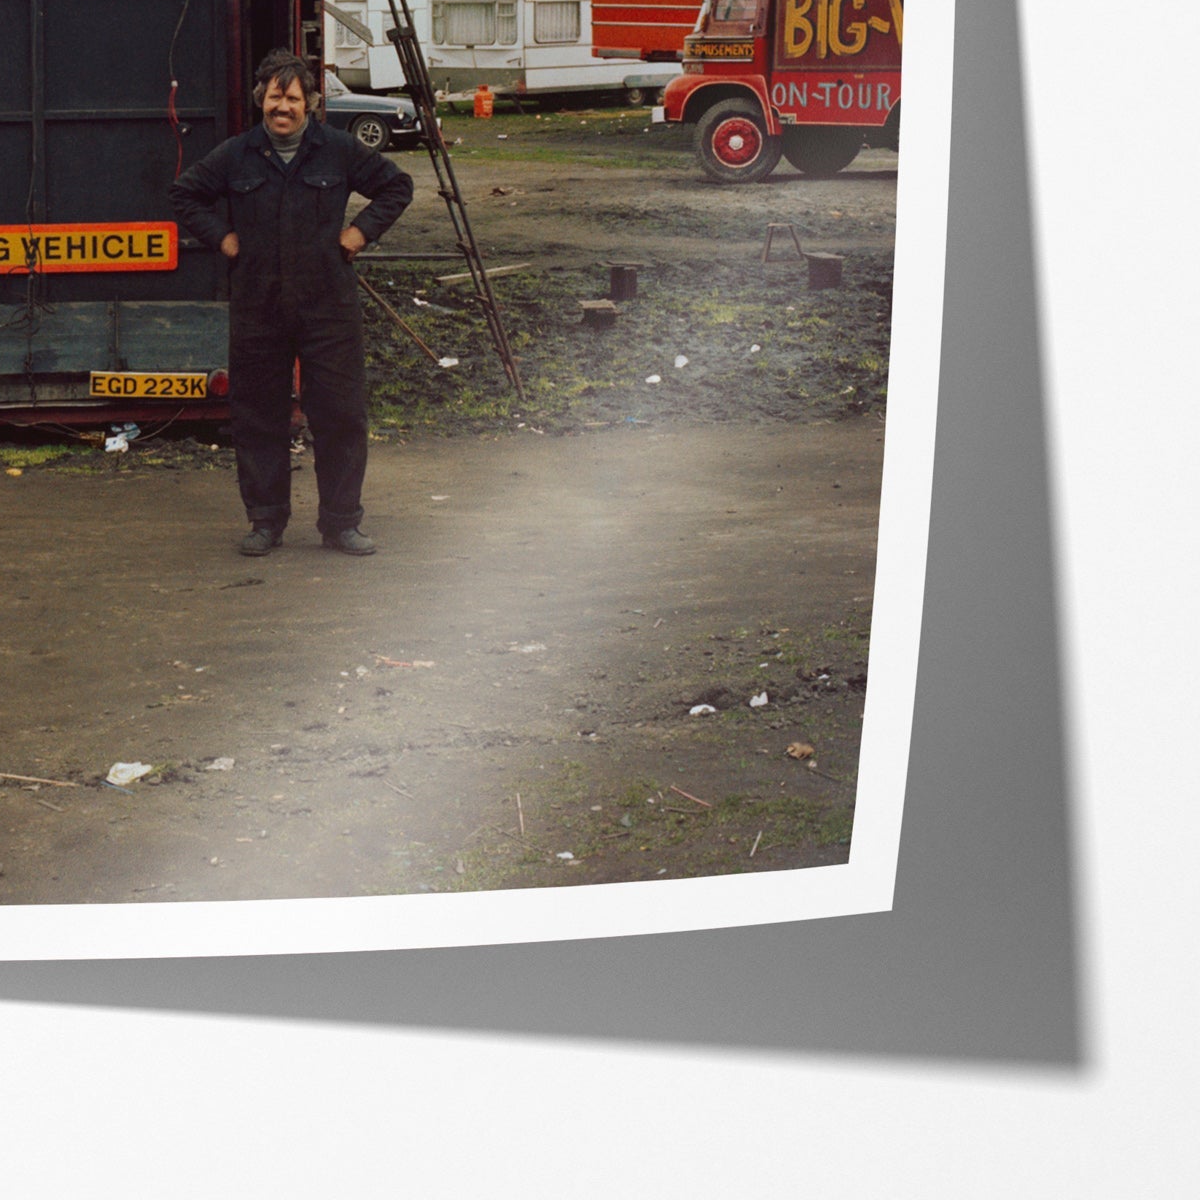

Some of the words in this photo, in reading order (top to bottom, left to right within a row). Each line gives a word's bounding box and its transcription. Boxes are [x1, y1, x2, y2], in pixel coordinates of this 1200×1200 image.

[21, 233, 165, 261] VEHICLE
[91, 376, 138, 395] EGD
[143, 377, 206, 396] 223K
